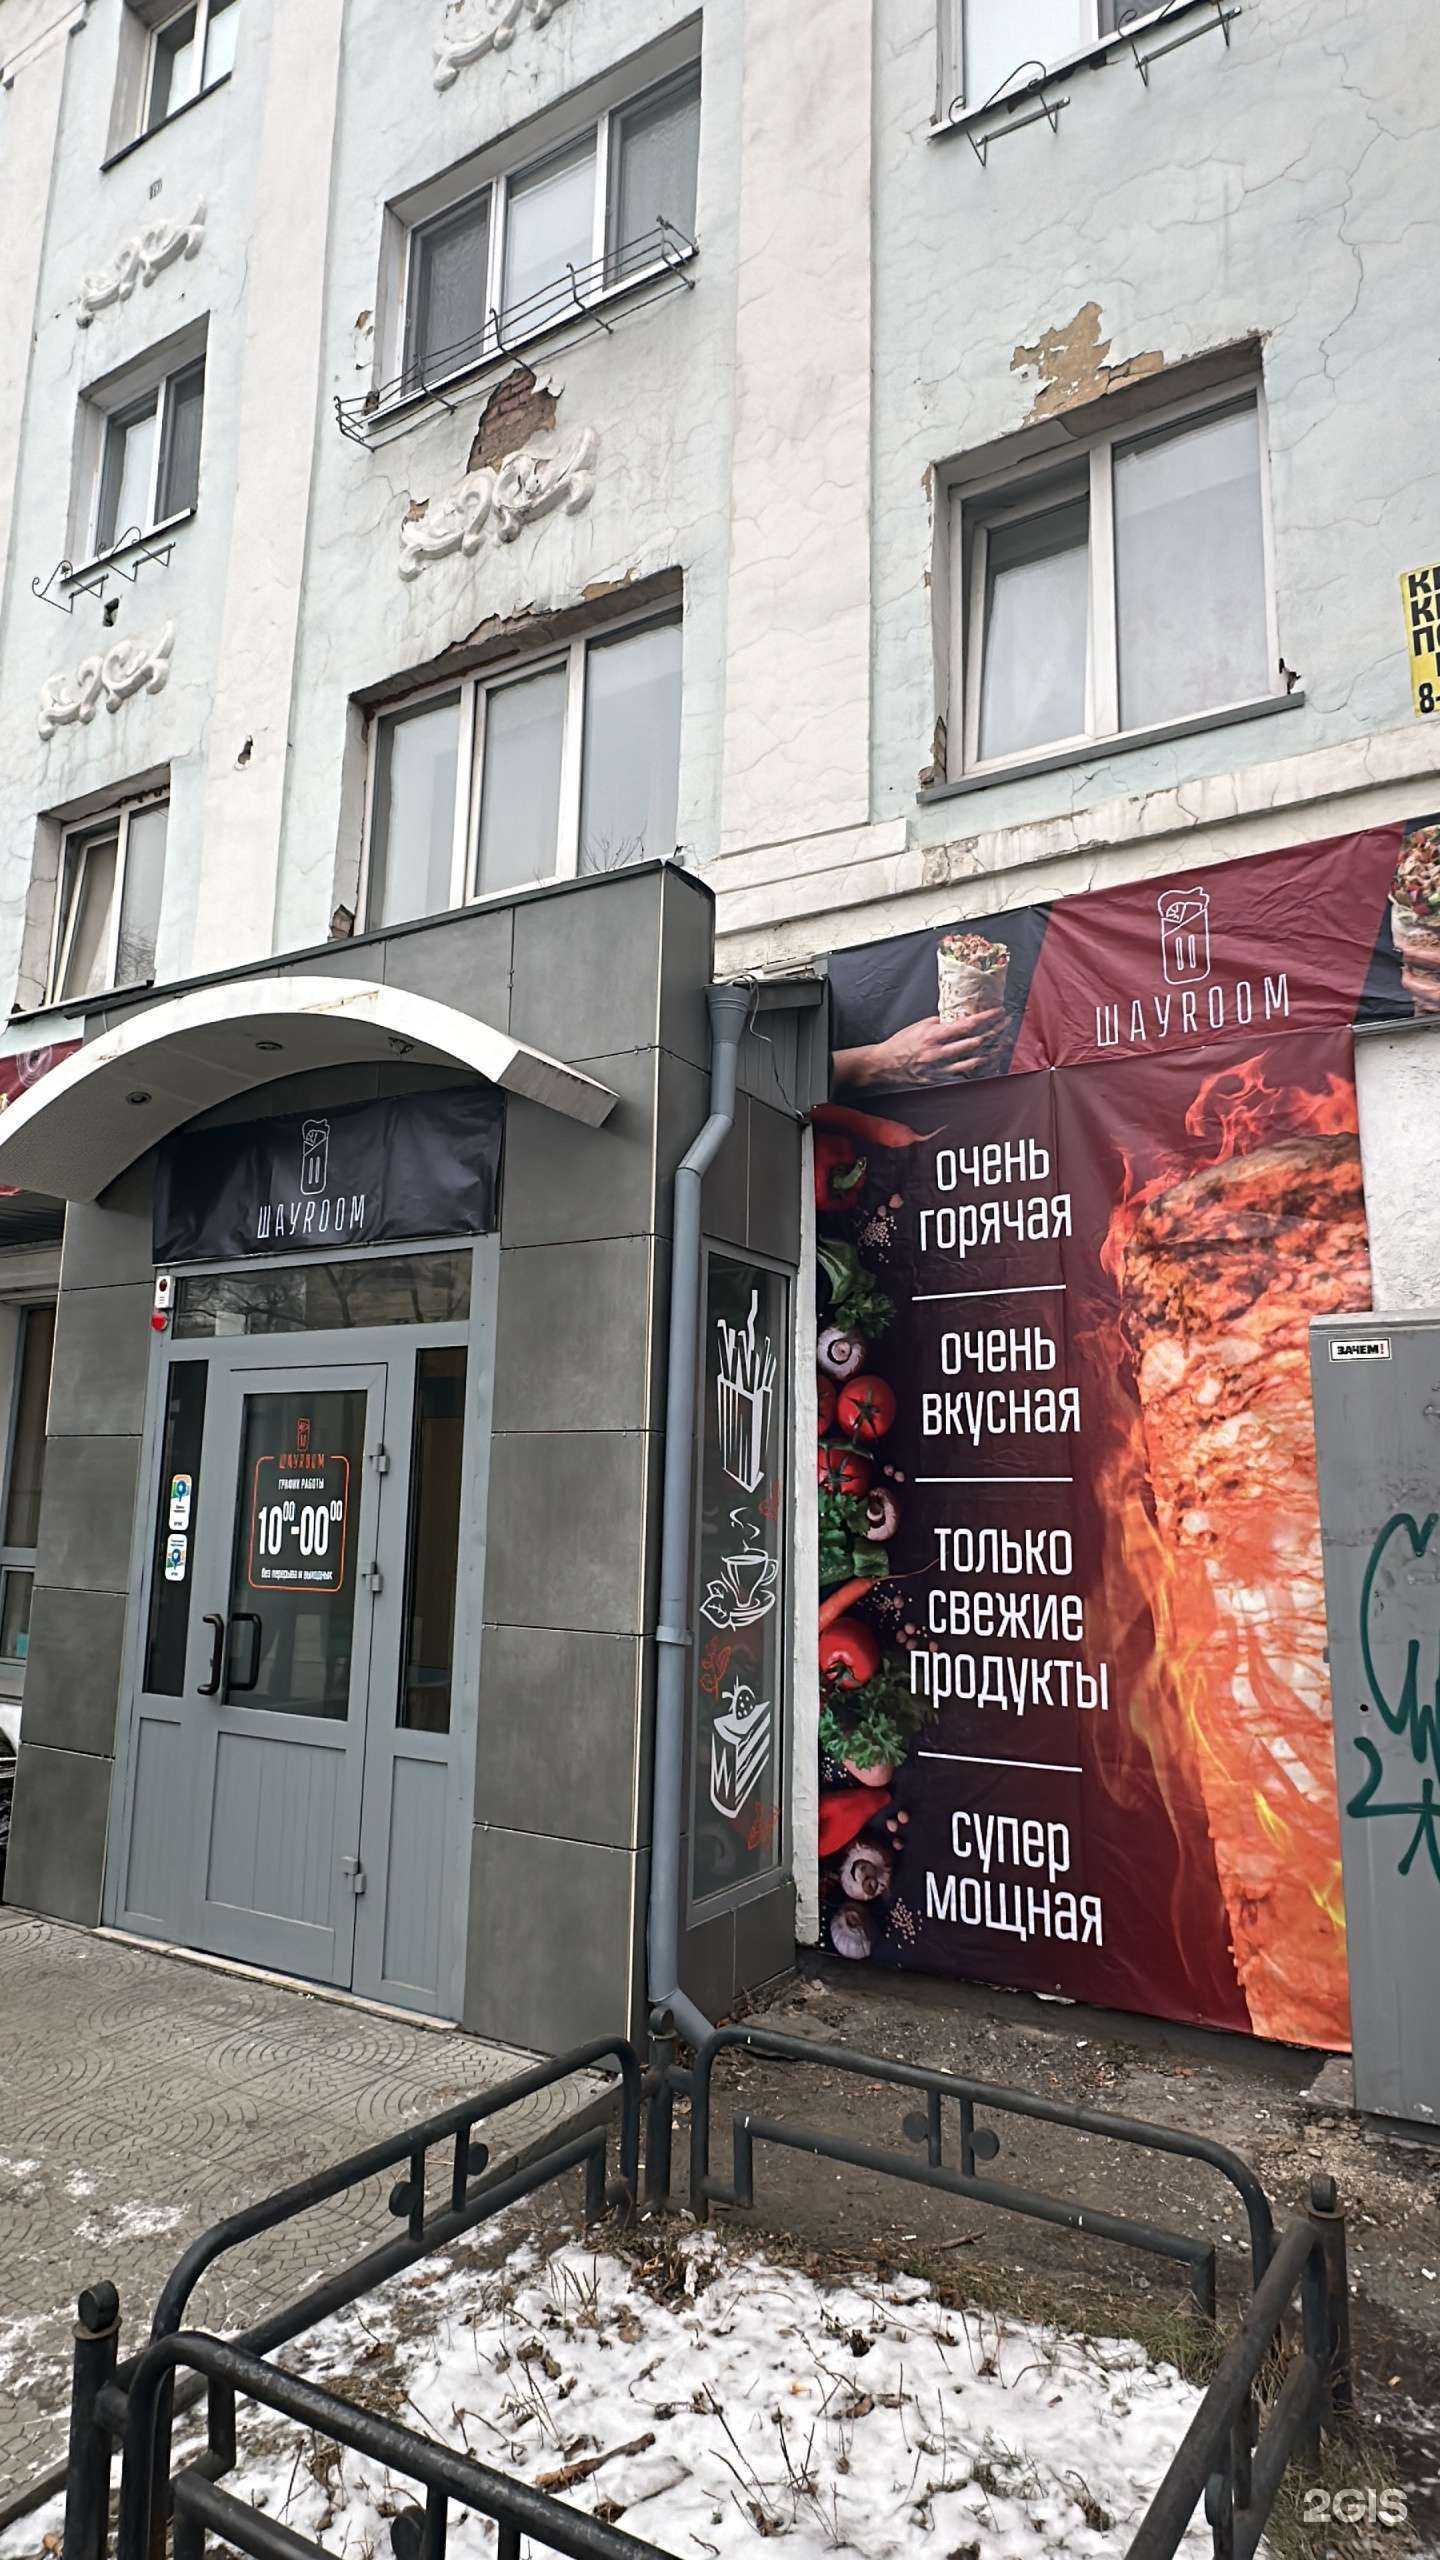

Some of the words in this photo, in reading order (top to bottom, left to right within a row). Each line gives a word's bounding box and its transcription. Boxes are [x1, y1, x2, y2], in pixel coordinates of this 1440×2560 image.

[937, 1138, 1050, 1191] очень
[919, 1194, 1072, 1259] горячая
[942, 1326, 1056, 1375] очень
[1337, 1343, 1384, 1355] ЗАЧЕМ!
[922, 1387, 1081, 1446] вкусная
[301, 1478, 324, 1490] РАБОТЫ
[934, 1528, 1073, 1576] только
[928, 1589, 1083, 1642] свежие
[910, 1650, 1109, 1716] продукты
[952, 1811, 1070, 1881] супер
[926, 1871, 1103, 1947] мощная
